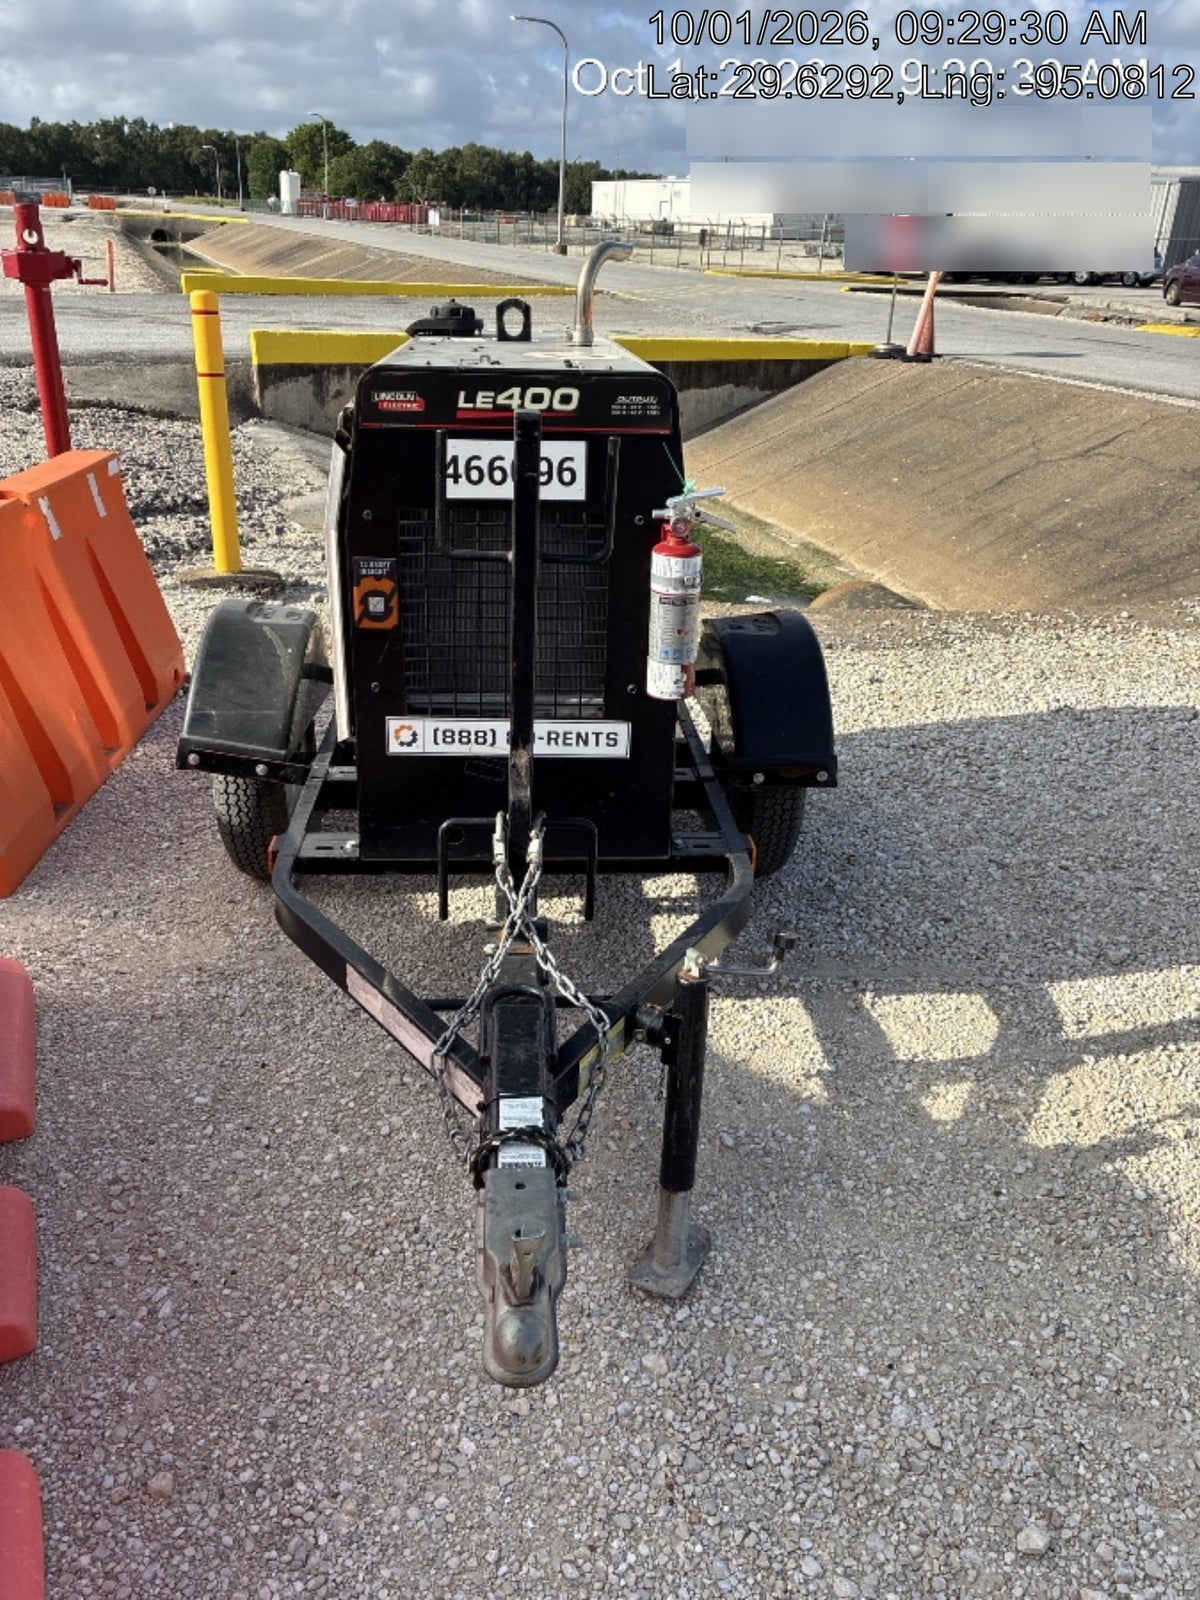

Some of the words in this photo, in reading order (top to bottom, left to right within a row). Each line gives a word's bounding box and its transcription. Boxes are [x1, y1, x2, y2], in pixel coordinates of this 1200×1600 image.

[374, 392, 416, 401] LINCOLN
[383, 401, 419, 409] ELECTRIC
[458, 386, 580, 411] LE400
[446, 454, 577, 487] 46696
[433, 726, 497, 746] (888)
[506, 730, 619, 748] -RENTS
